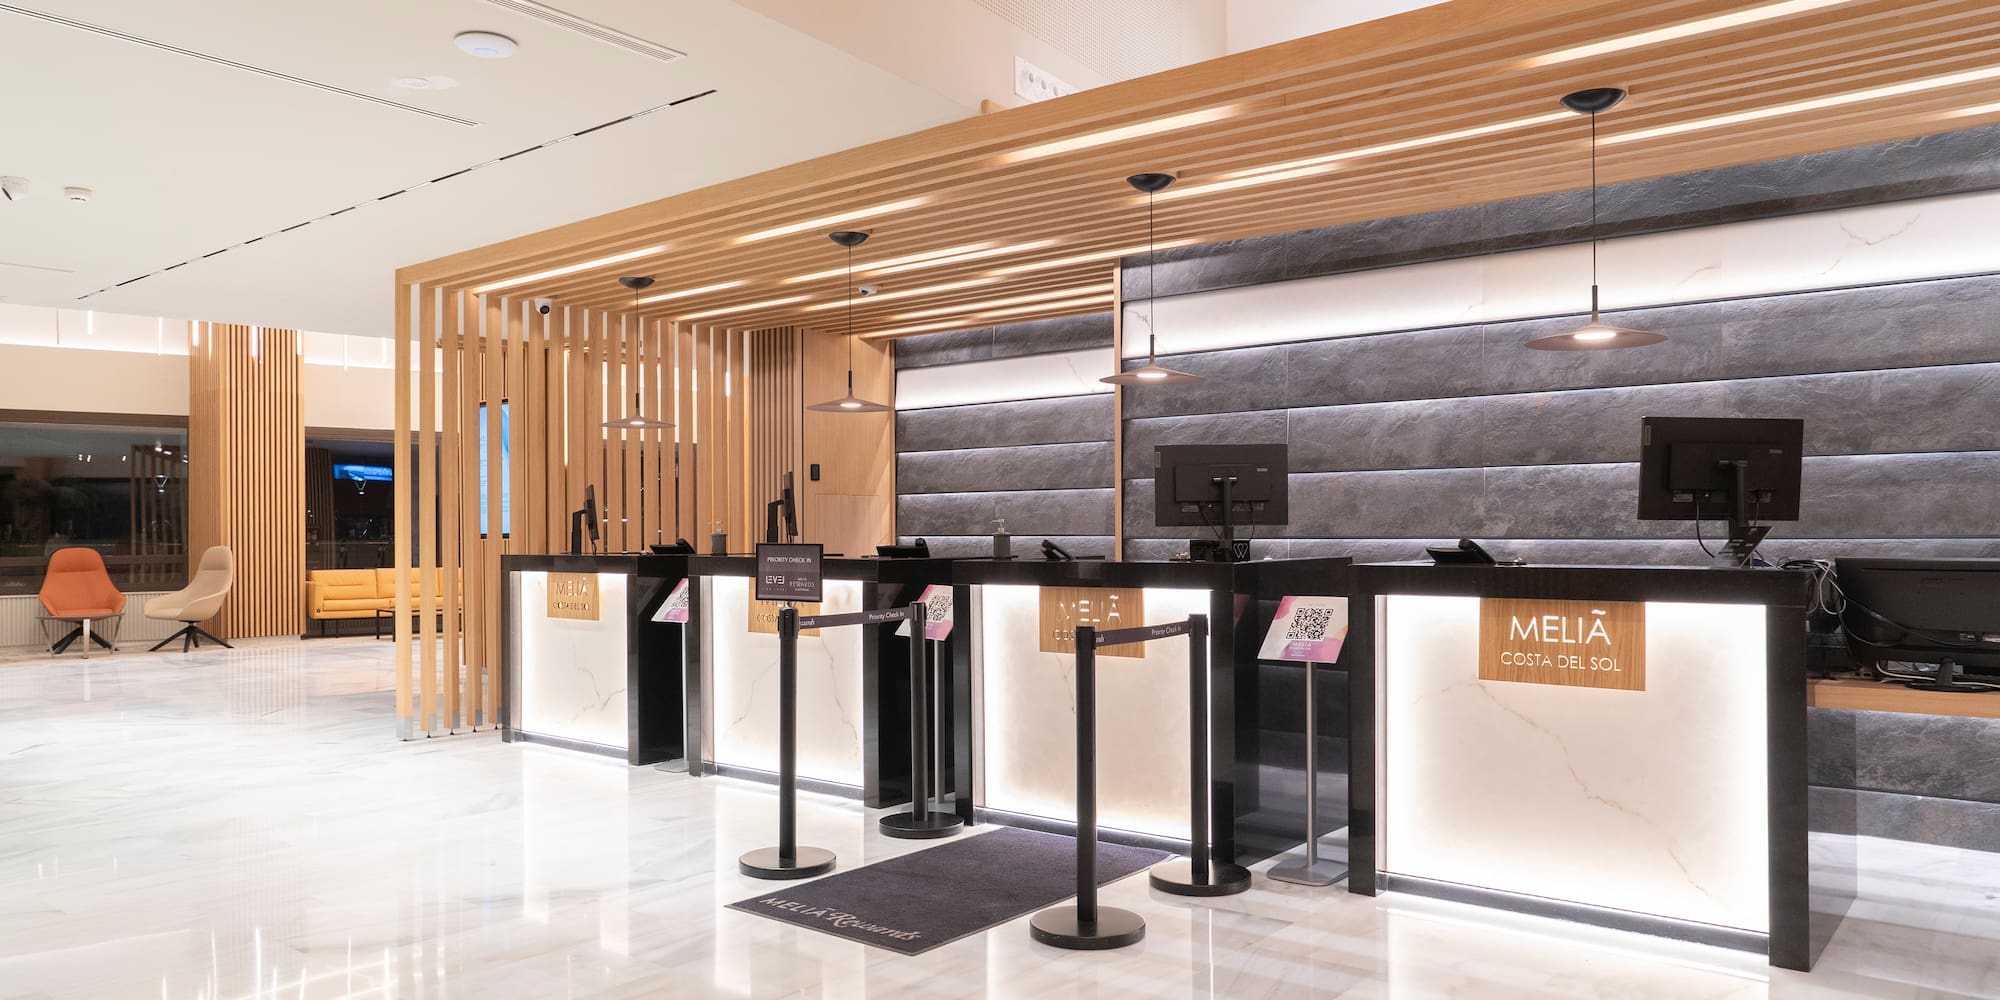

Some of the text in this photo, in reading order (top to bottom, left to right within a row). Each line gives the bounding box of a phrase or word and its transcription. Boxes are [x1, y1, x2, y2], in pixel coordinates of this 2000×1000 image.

[789, 556, 805, 564] CHECK
[1053, 629, 1076, 640] COS
[1509, 609, 1612, 646] MELIÃ
[1500, 651, 1622, 672] COSTA DEL SOL
[825, 911, 921, 942] Rewards
